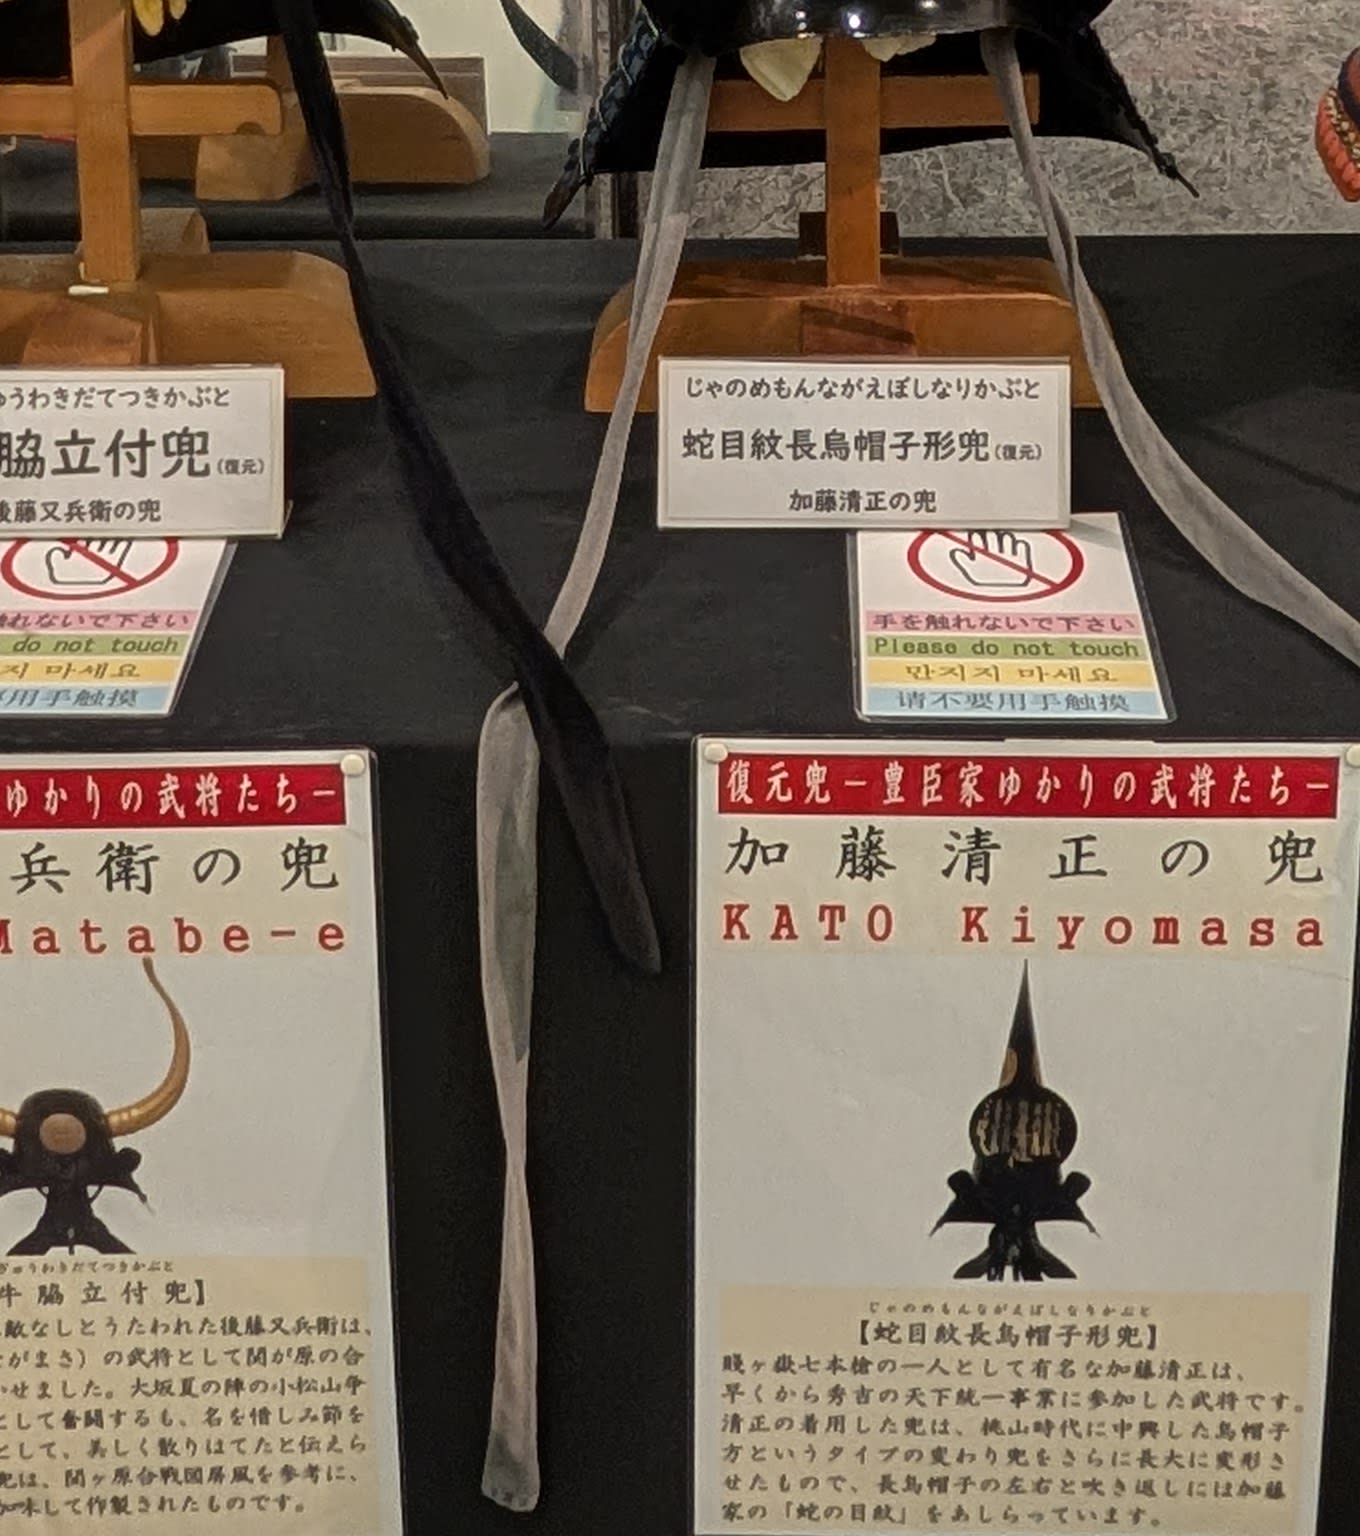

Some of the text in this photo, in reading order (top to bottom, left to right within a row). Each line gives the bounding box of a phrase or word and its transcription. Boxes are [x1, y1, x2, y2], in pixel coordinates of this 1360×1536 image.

[685, 376, 1040, 401] じゃのめもんながえぼしなりかぶと
[788, 488, 938, 514] 加藤清正の兜
[872, 614, 1136, 632] 手を触れないで下さい
[12, 636, 41, 654] do
[52, 637, 97, 654] not
[110, 636, 180, 654] touch
[873, 638, 1140, 657] Please do not touch
[45, 662, 142, 681] 마세요
[905, 664, 1119, 683] 만지지 마세요
[724, 825, 1325, 886] 加藤清正の兜
[722, 903, 1325, 951] KATO Kiyomasa
